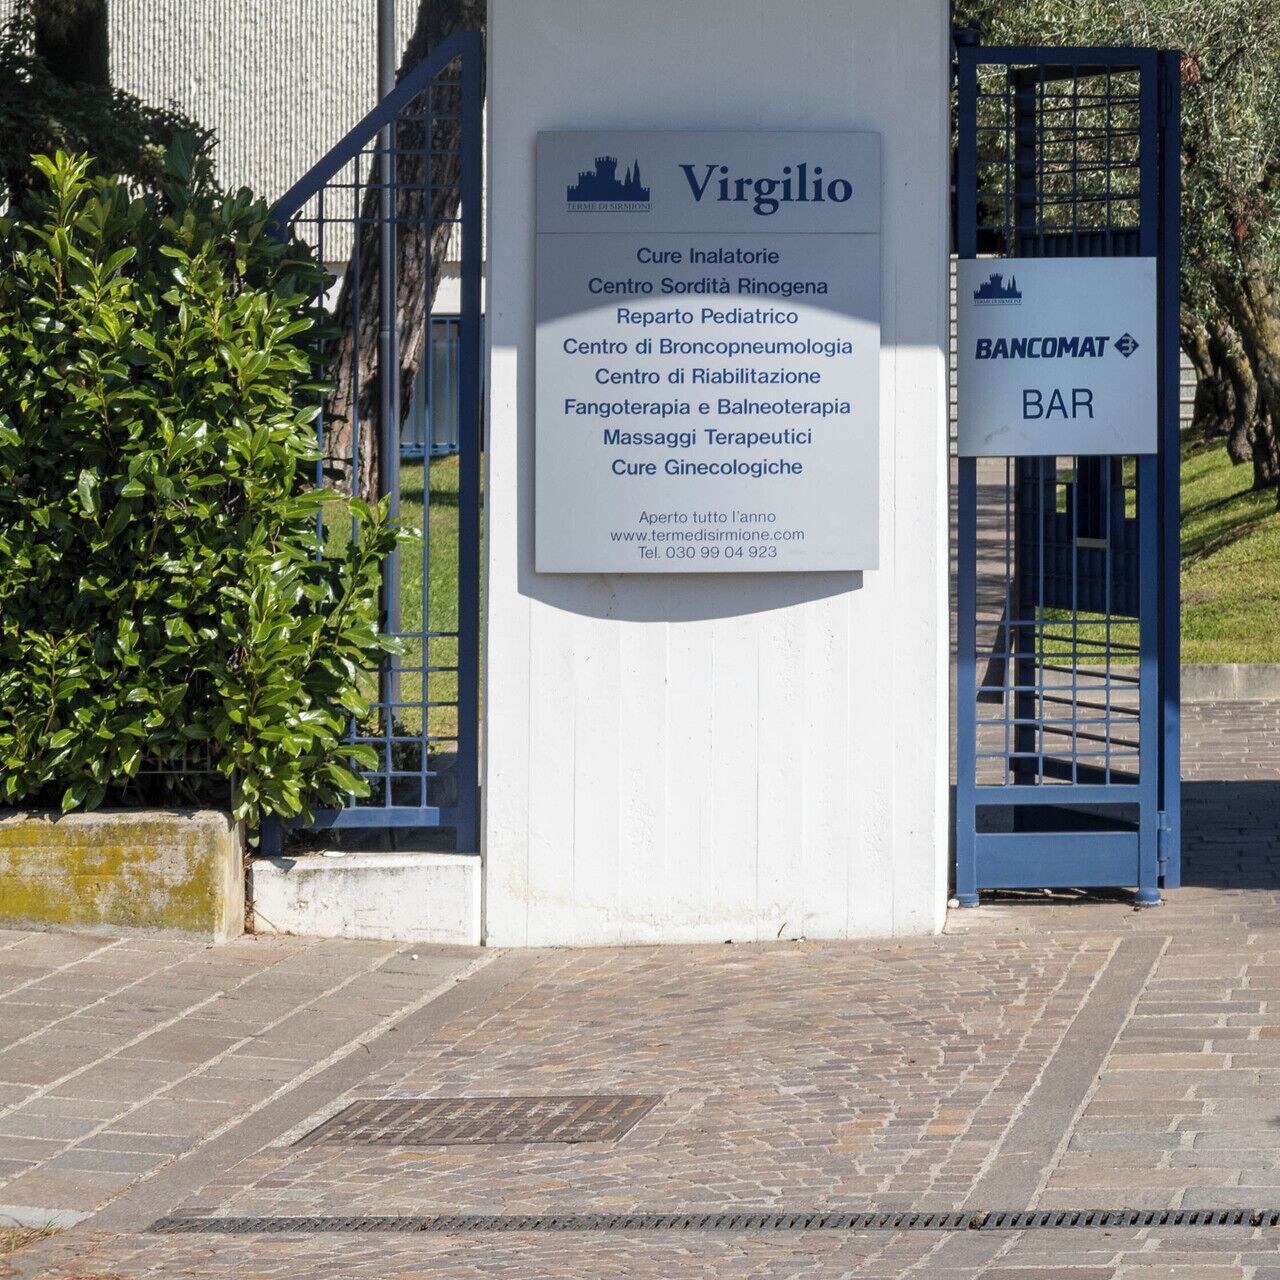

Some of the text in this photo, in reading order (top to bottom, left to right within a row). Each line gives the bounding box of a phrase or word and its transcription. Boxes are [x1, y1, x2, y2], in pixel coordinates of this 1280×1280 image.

[679, 162, 853, 216] Virgilio
[636, 247, 780, 265] Cure Inalatorie
[588, 277, 829, 298] Centro Sordità Rinogena
[617, 307, 798, 326] Reparto Pediatrico
[563, 337, 853, 358] Centro di Broncopneumologia
[975, 336, 1110, 360] BANCOMAT
[595, 367, 822, 385] Centro di Riabilitazione
[564, 398, 851, 419] Fangoterapia e Balneoterapia
[1022, 388, 1095, 419] BAR
[603, 428, 812, 449] Massaggi Terapeutici
[611, 458, 803, 479] Cure Ginecologiche
[639, 511, 777, 525] Aperto tutto l'anno
[610, 528, 805, 542] www.termedisirmione.com
[638, 546, 778, 559] Tel. 030 99 04 923
